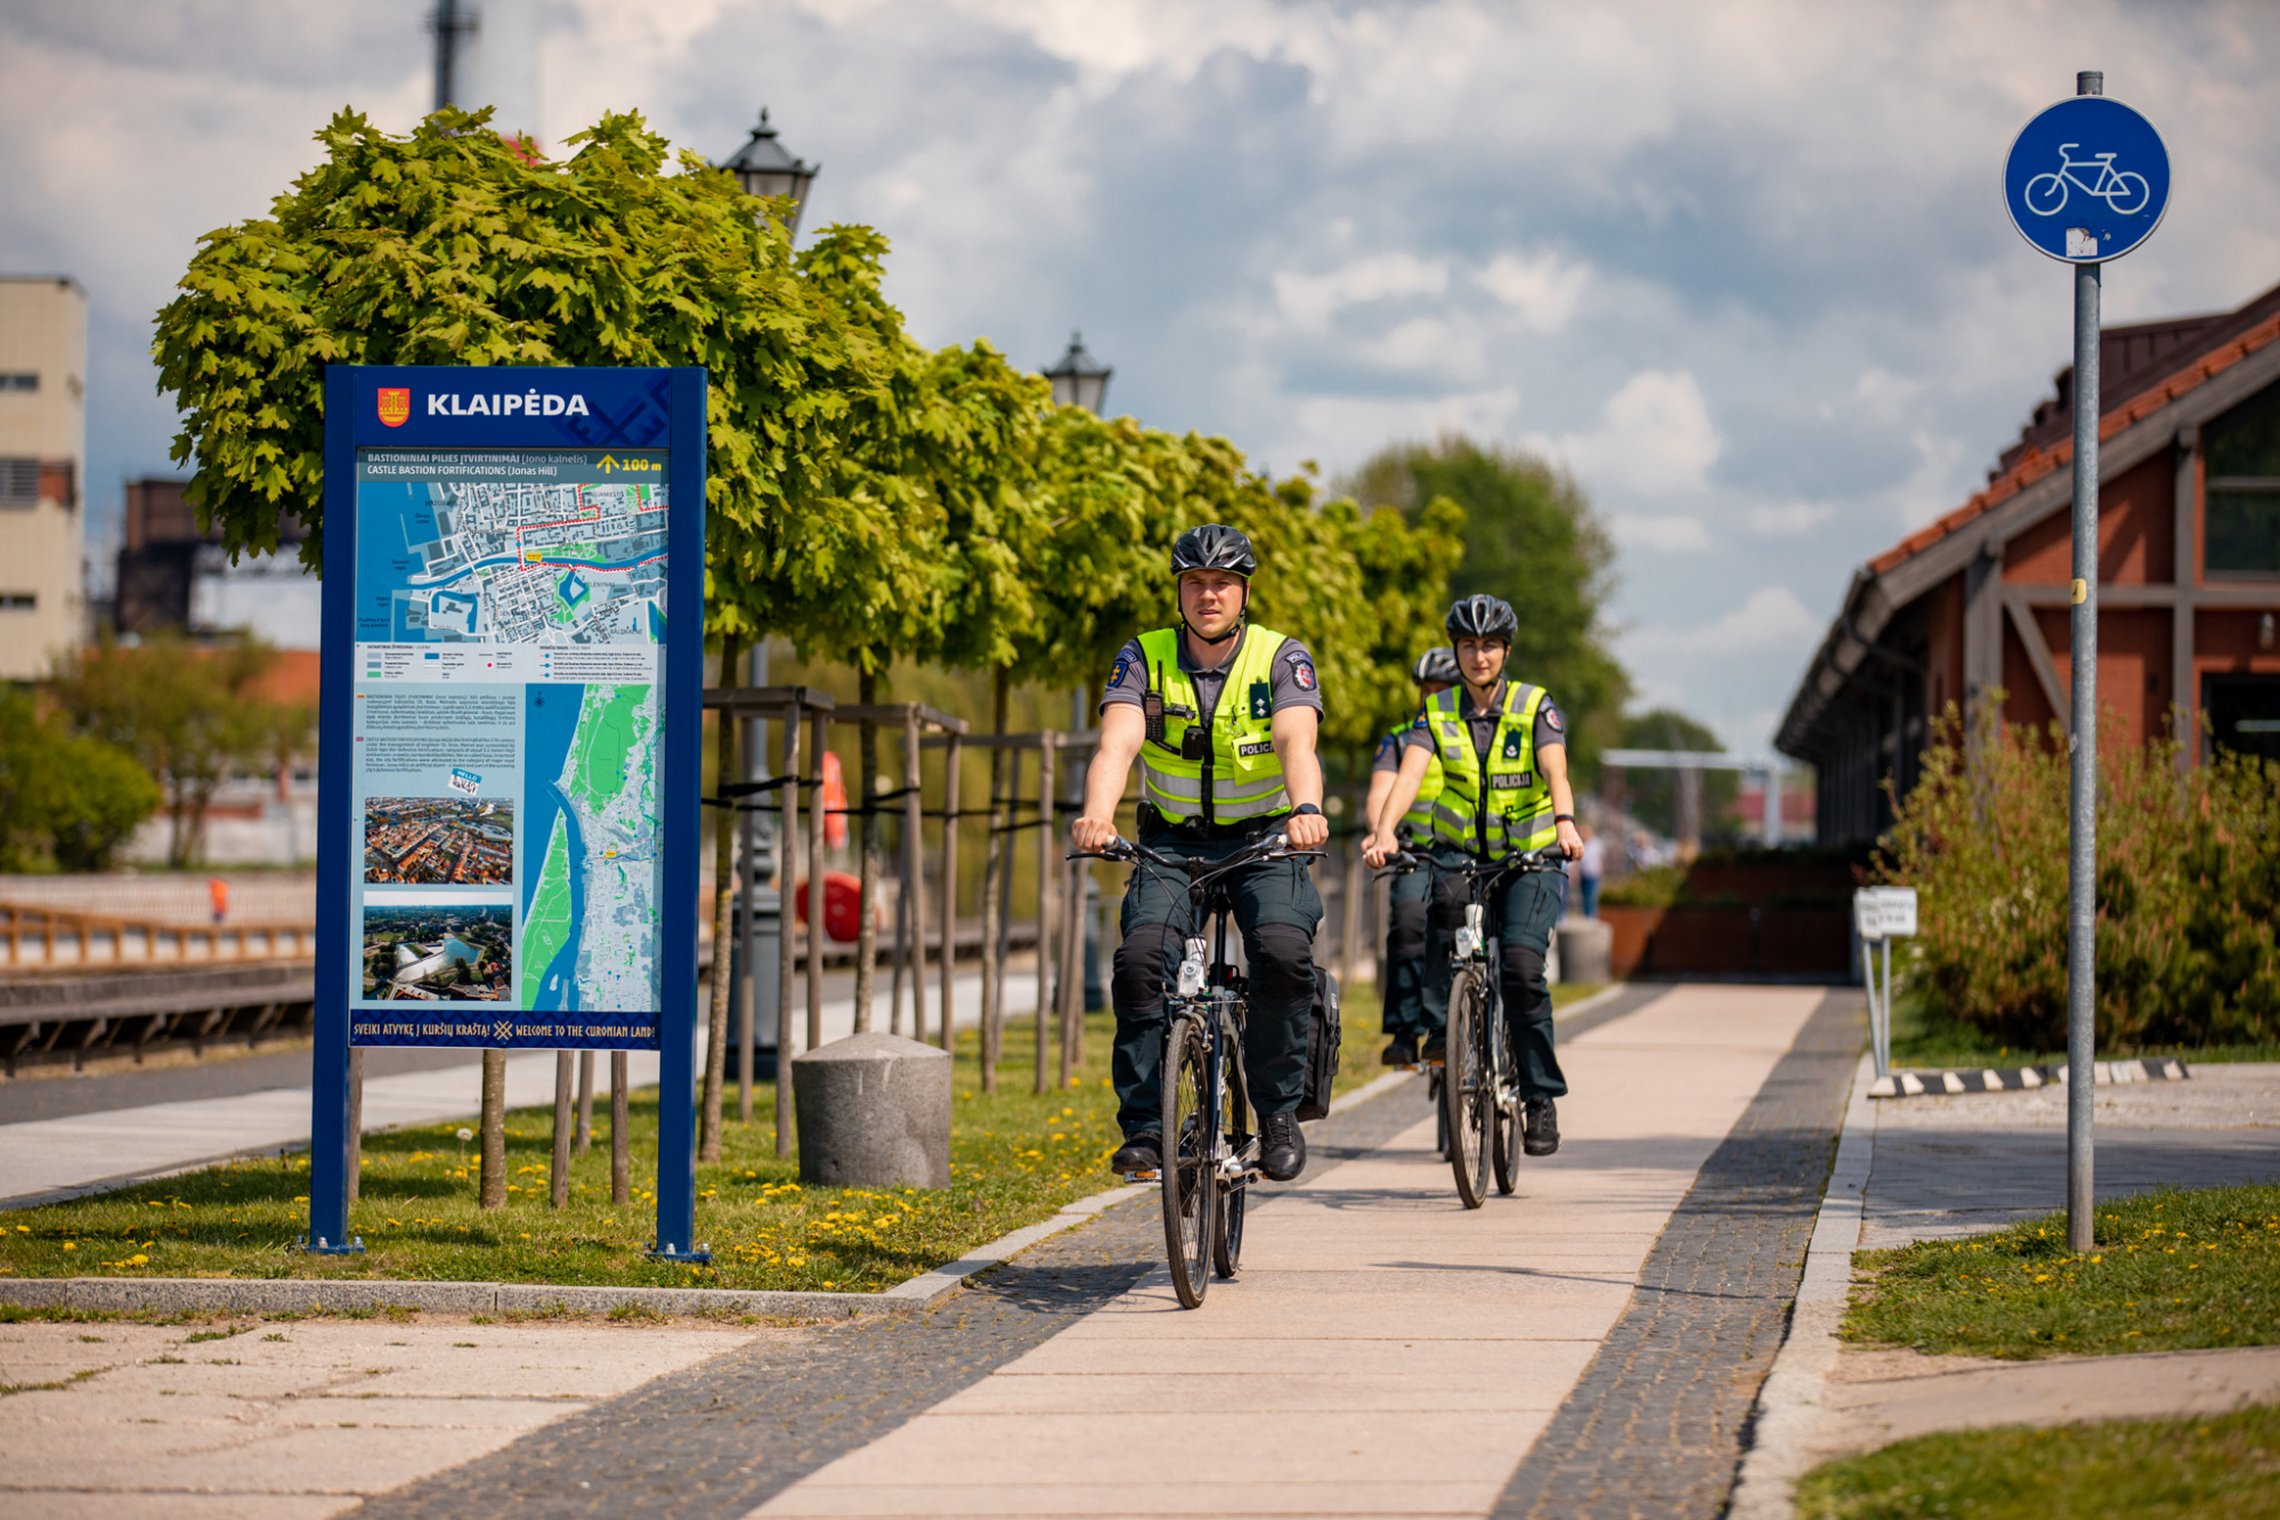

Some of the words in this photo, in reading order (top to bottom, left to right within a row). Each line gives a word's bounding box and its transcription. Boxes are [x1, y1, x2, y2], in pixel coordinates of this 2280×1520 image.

[427, 388, 589, 416] KLAIPĖDA
[367, 453, 430, 463] BASTIONINIAI
[431, 454, 459, 463] PILIES
[521, 454, 547, 465] (Jono
[547, 454, 588, 465] kalnelis)
[622, 459, 649, 471] 100
[651, 462, 662, 471] m
[367, 465, 397, 475] CASTLE
[399, 465, 436, 475] BASTION
[438, 465, 506, 476] FORTIFICATIONS
[507, 466, 537, 477] (Jonas
[538, 466, 557, 477] Hill)
[1240, 744, 1274, 756] POLICI
[1492, 774, 1531, 788] POLICIJA
[354, 1023, 381, 1035] SVEIKI
[382, 1023, 414, 1037] ATVYKĘ
[422, 1022, 453, 1037] KURŠIŲ
[456, 1022, 491, 1037] KRAŠTĄ!
[515, 1025, 553, 1036] WELCOME
[555, 1025, 565, 1037] TO
[567, 1025, 583, 1037] THE
[585, 1026, 628, 1037] CURONIAN
[630, 1026, 655, 1038] LAND!
